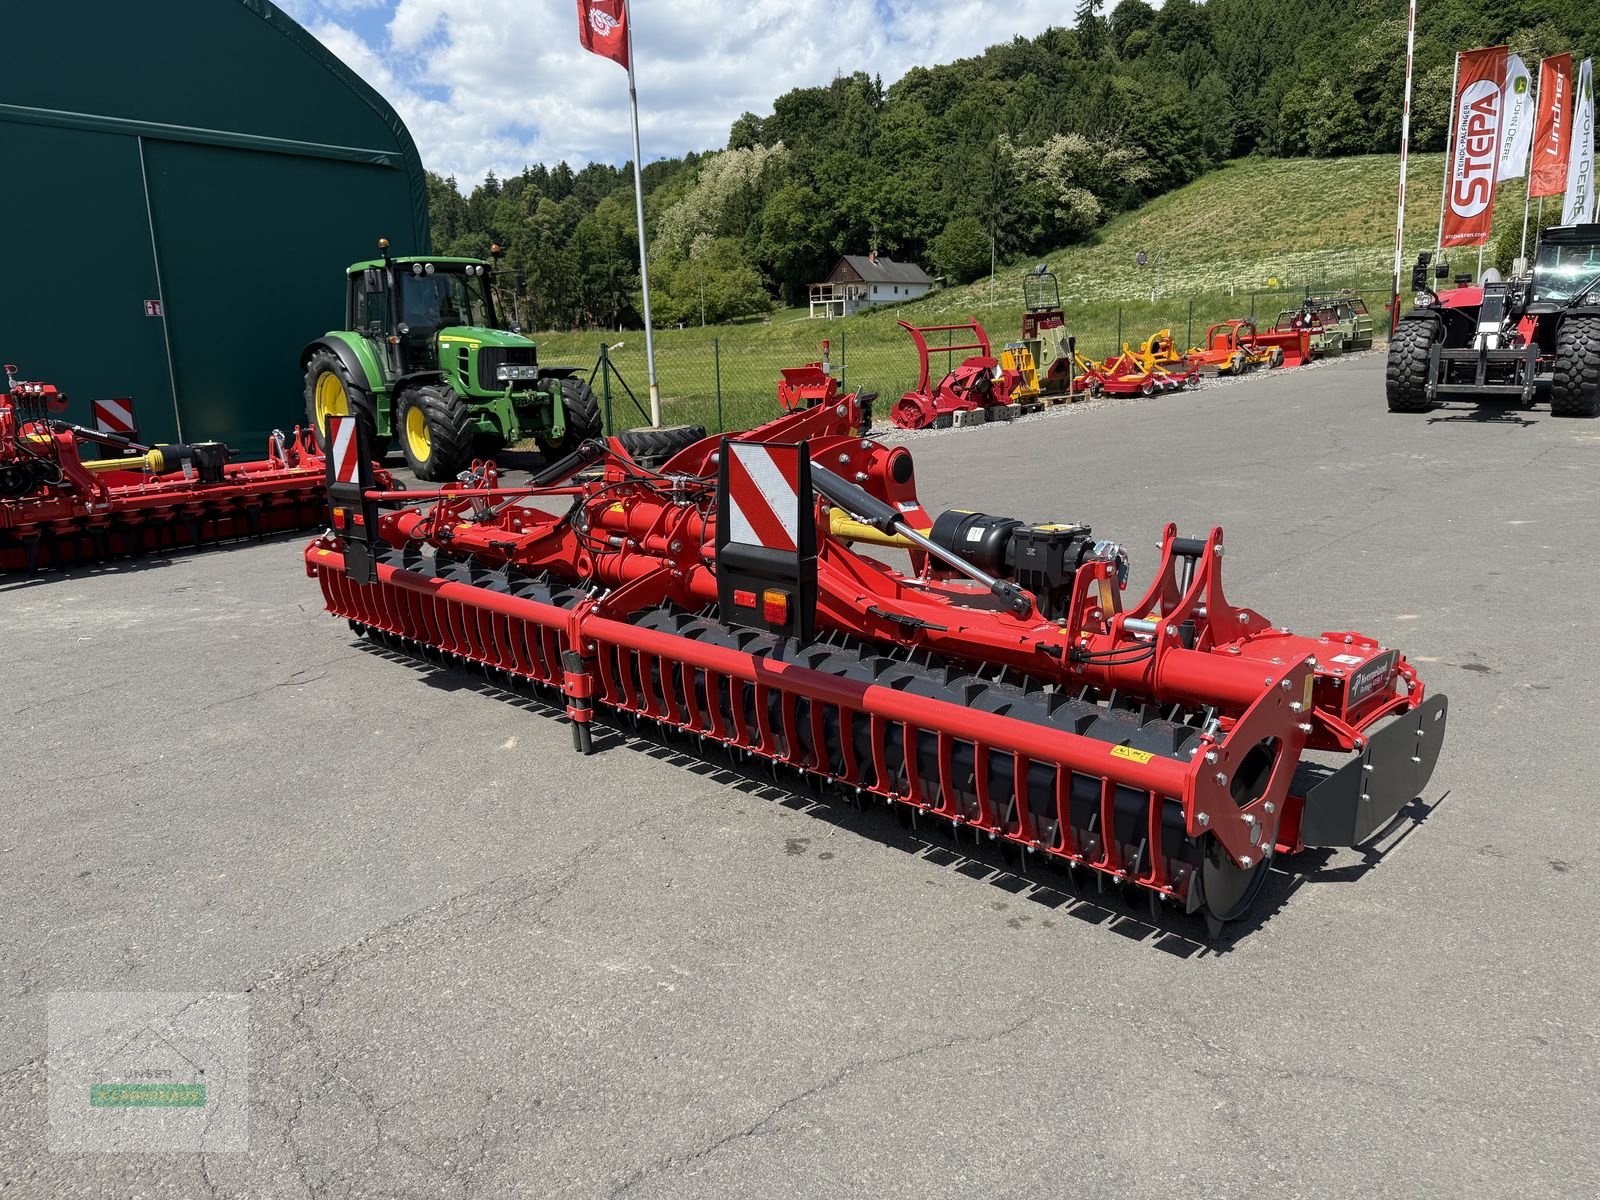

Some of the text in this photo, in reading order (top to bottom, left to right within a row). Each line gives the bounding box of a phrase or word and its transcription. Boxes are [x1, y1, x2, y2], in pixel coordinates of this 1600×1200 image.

[1453, 90, 1499, 207] STEPA
[1501, 98, 1524, 162] JOHN DEERE
[1546, 64, 1565, 156] Lindner
[1574, 109, 1590, 216] JOHN DEERE
